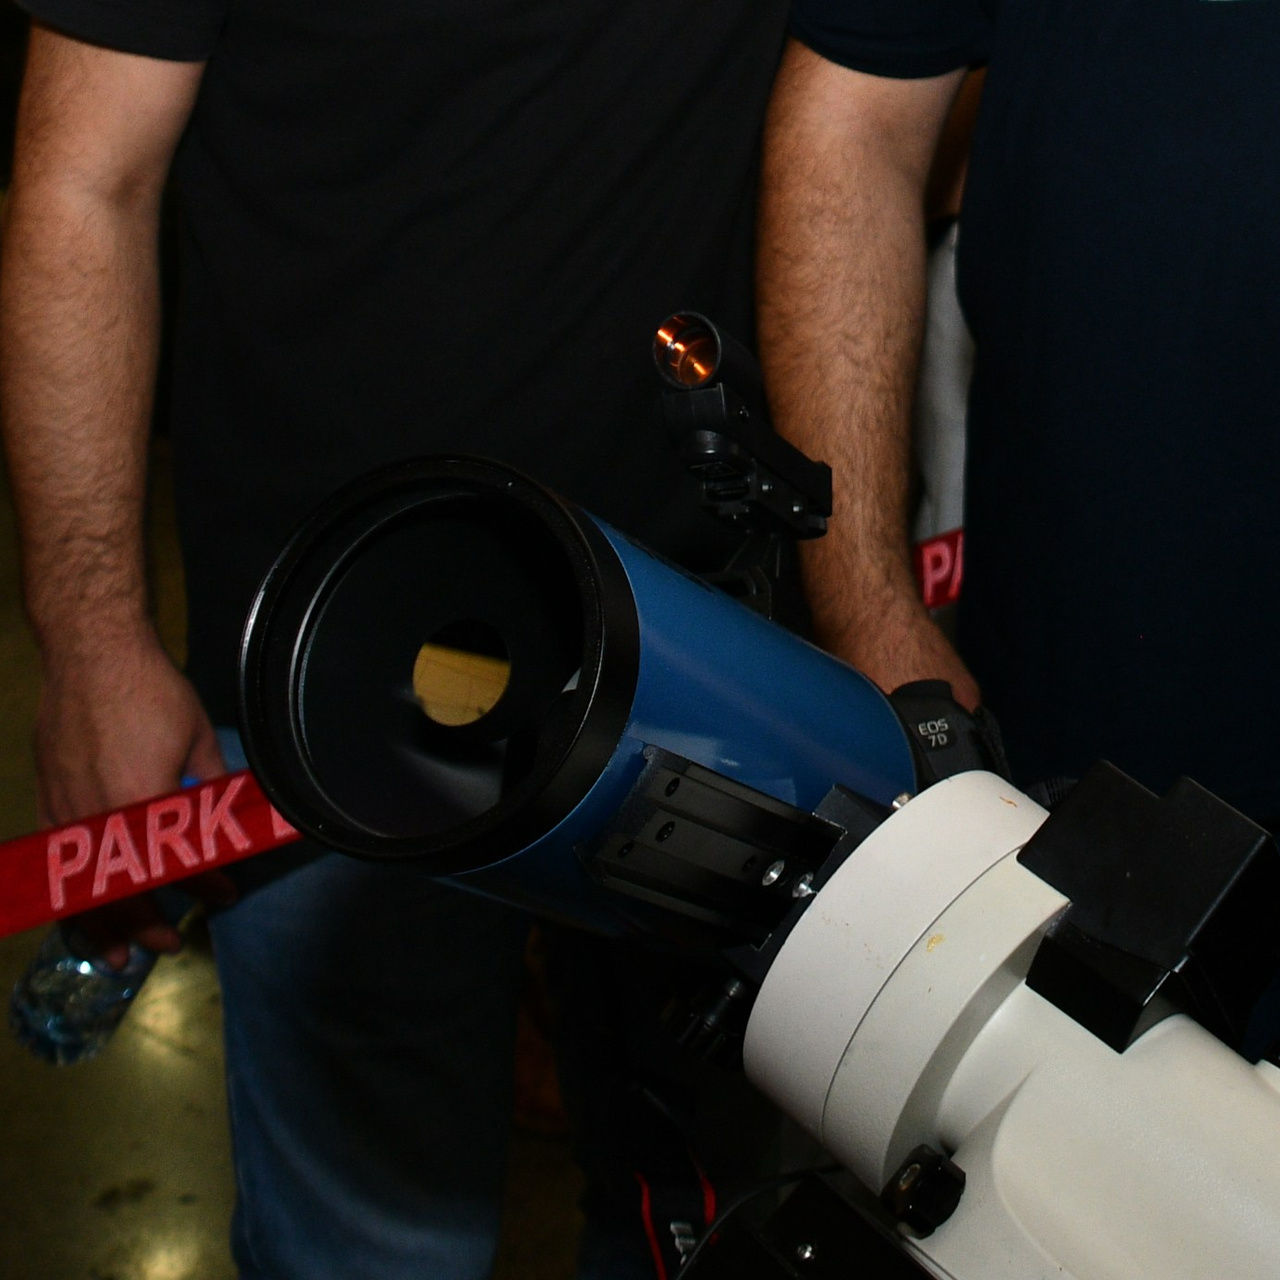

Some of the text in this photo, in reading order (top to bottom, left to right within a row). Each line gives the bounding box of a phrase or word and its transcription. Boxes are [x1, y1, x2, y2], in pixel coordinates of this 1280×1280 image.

[918, 718, 949, 736] EOS
[927, 733, 948, 748] 7D
[47, 775, 252, 911] PARK
